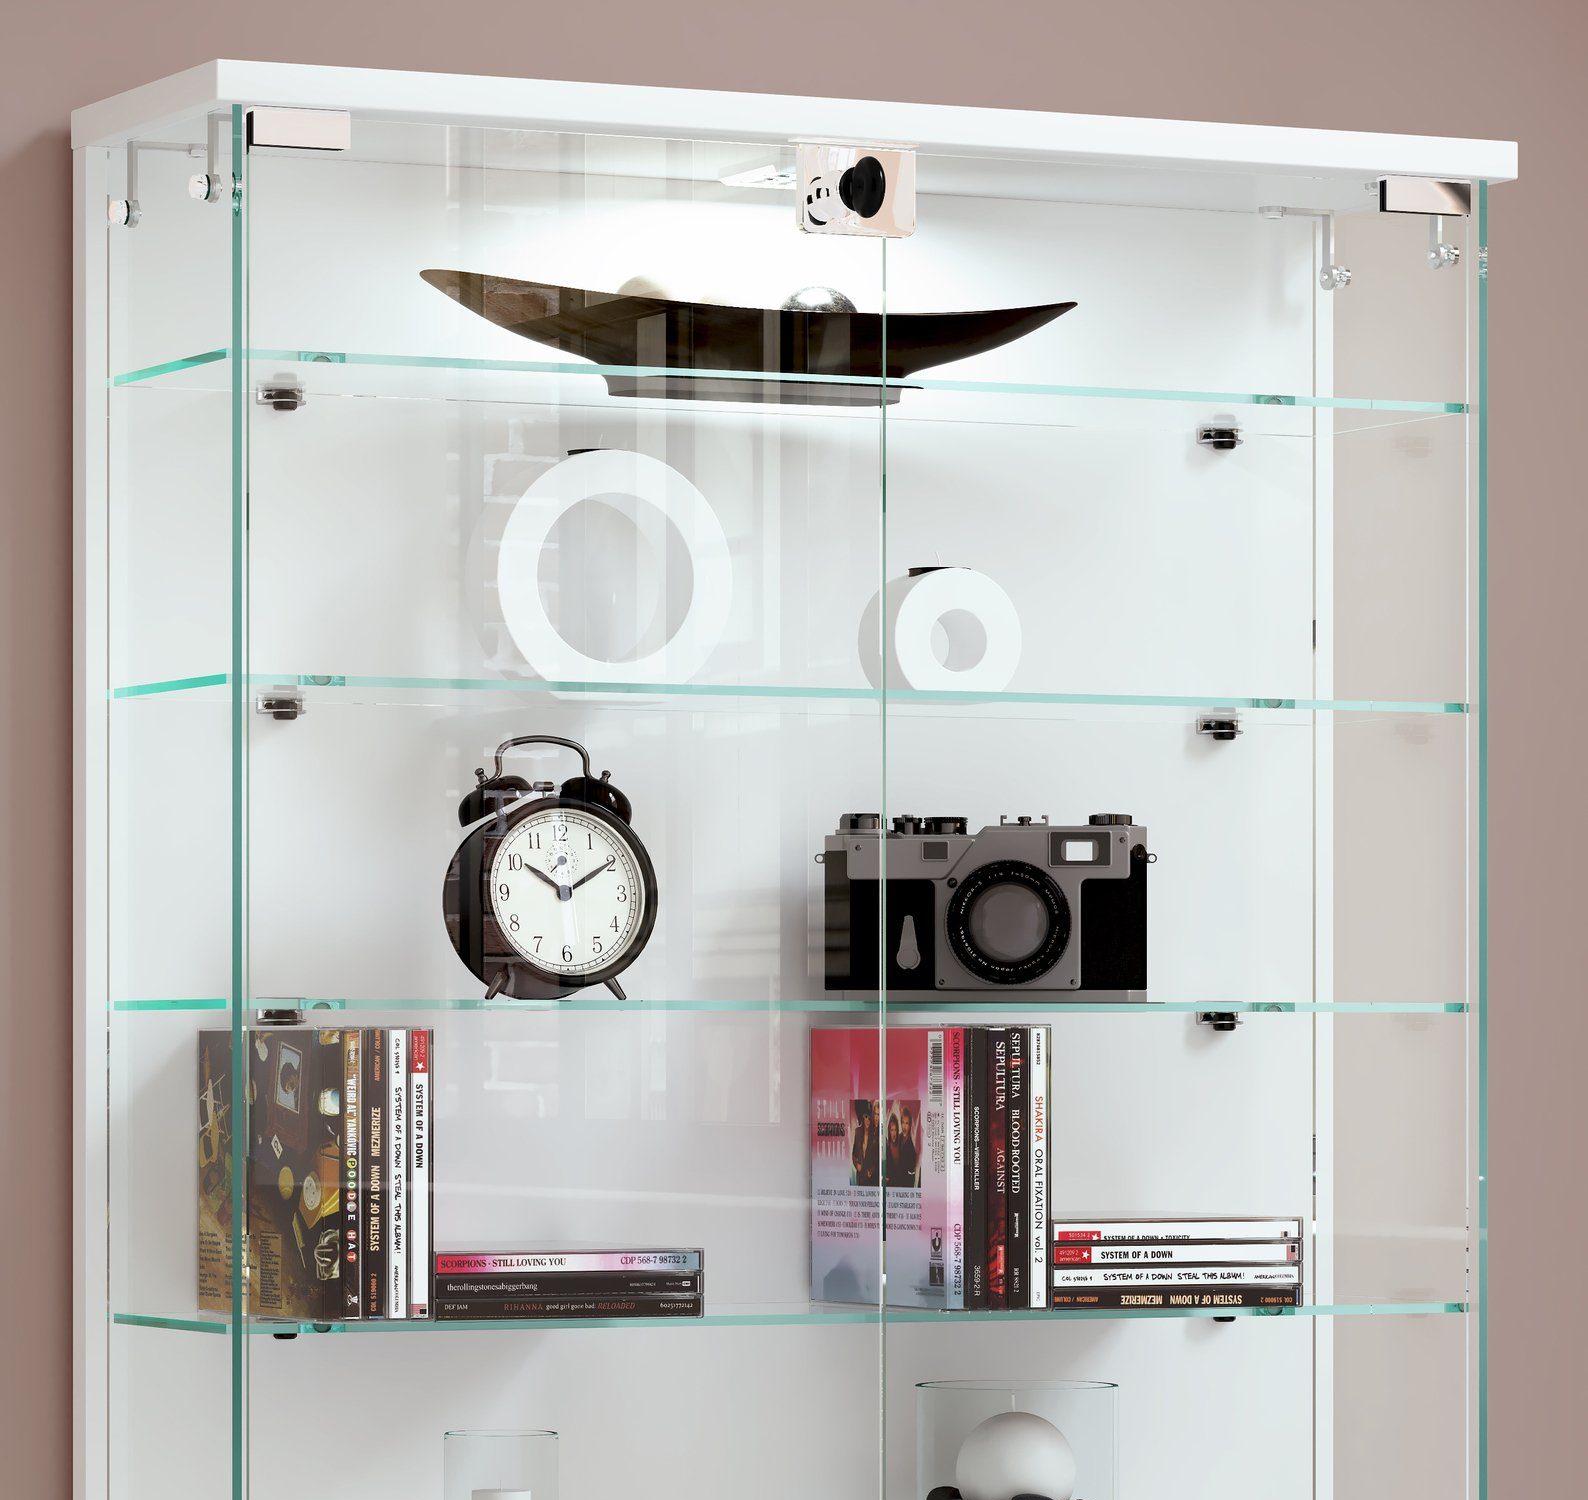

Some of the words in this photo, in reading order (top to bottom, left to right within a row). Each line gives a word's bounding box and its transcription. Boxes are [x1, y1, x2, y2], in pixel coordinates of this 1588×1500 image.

[528, 832, 541, 849] 11
[552, 824, 569, 842] 12
[587, 833, 592, 850] 1
[508, 853, 523, 871] 10
[606, 854, 617, 872] 2
[499, 884, 510, 901] 9
[616, 885, 627, 902] 3
[510, 914, 520, 932] 8
[610, 916, 620, 932] 4
[533, 936, 543, 953] 7
[562, 945, 573, 962] 6
[592, 936, 602, 953] 5
[952, 1032, 961, 1084] SCORPIONS
[1012, 1032, 1020, 1099] SEPULTURA
[996, 1041, 1006, 1111] SEPULTURA
[394, 1087, 402, 1122] SYSTEM
[416, 1084, 424, 1118] SYSTEM
[953, 1086, 961, 1112] STILL
[416, 1120, 424, 1132] OF
[953, 1112, 961, 1144] LOVING
[1034, 1096, 1044, 1142] SHAKIRA
[346, 1119, 357, 1156] YANKOVIC
[371, 1106, 381, 1157] MEZMERIZE
[394, 1124, 402, 1136] OF
[416, 1142, 424, 1169] DOWN
[1034, 1148, 1044, 1178] ORAL
[371, 1165, 381, 1194] DOWN
[996, 1148, 1005, 1194] AGAINST
[346, 1157, 358, 1221] POODLE
[394, 1174, 402, 1200] STEAL
[370, 1202, 380, 1214] OF
[394, 1203, 402, 1222] THIS
[1034, 1181, 1044, 1230] FIXATION
[370, 1216, 380, 1252] SYSTEM
[394, 1224, 402, 1254] ALBUM!
[346, 1229, 358, 1263] HAT
[1034, 1236, 1044, 1254] vol.
[440, 1258, 487, 1269] SCORPIONS
[492, 1258, 515, 1268] STILL
[516, 1258, 547, 1268] LOVING
[548, 1257, 567, 1267] YOU
[620, 1256, 636, 1266] CDP
[637, 1256, 658, 1265] 568-7
[658, 1255, 680, 1264] 98732
[1100, 1250, 1130, 1260] SYSTEM
[1132, 1250, 1142, 1260] OF
[1143, 1250, 1150, 1260] A
[1150, 1250, 1174, 1260] DOWN
[1103, 1272, 1134, 1282] SYSTEM
[1135, 1272, 1144, 1281] OF
[1151, 1272, 1174, 1280] DOWN
[1177, 1272, 1201, 1280] STEAL
[1202, 1272, 1218, 1280] THIS
[1219, 1272, 1246, 1280] ALBUM!
[446, 1281, 538, 1293] therollingstonesabiggerbang
[546, 1303, 559, 1312] good
[560, 1302, 570, 1311] girl
[597, 1302, 636, 1310] RELOADED
[1120, 1295, 1163, 1306] MEZMERIZE
[1170, 1295, 1192, 1305] DOWN
[1201, 1294, 1211, 1304] OF
[1213, 1294, 1243, 1304] SYSTEM
